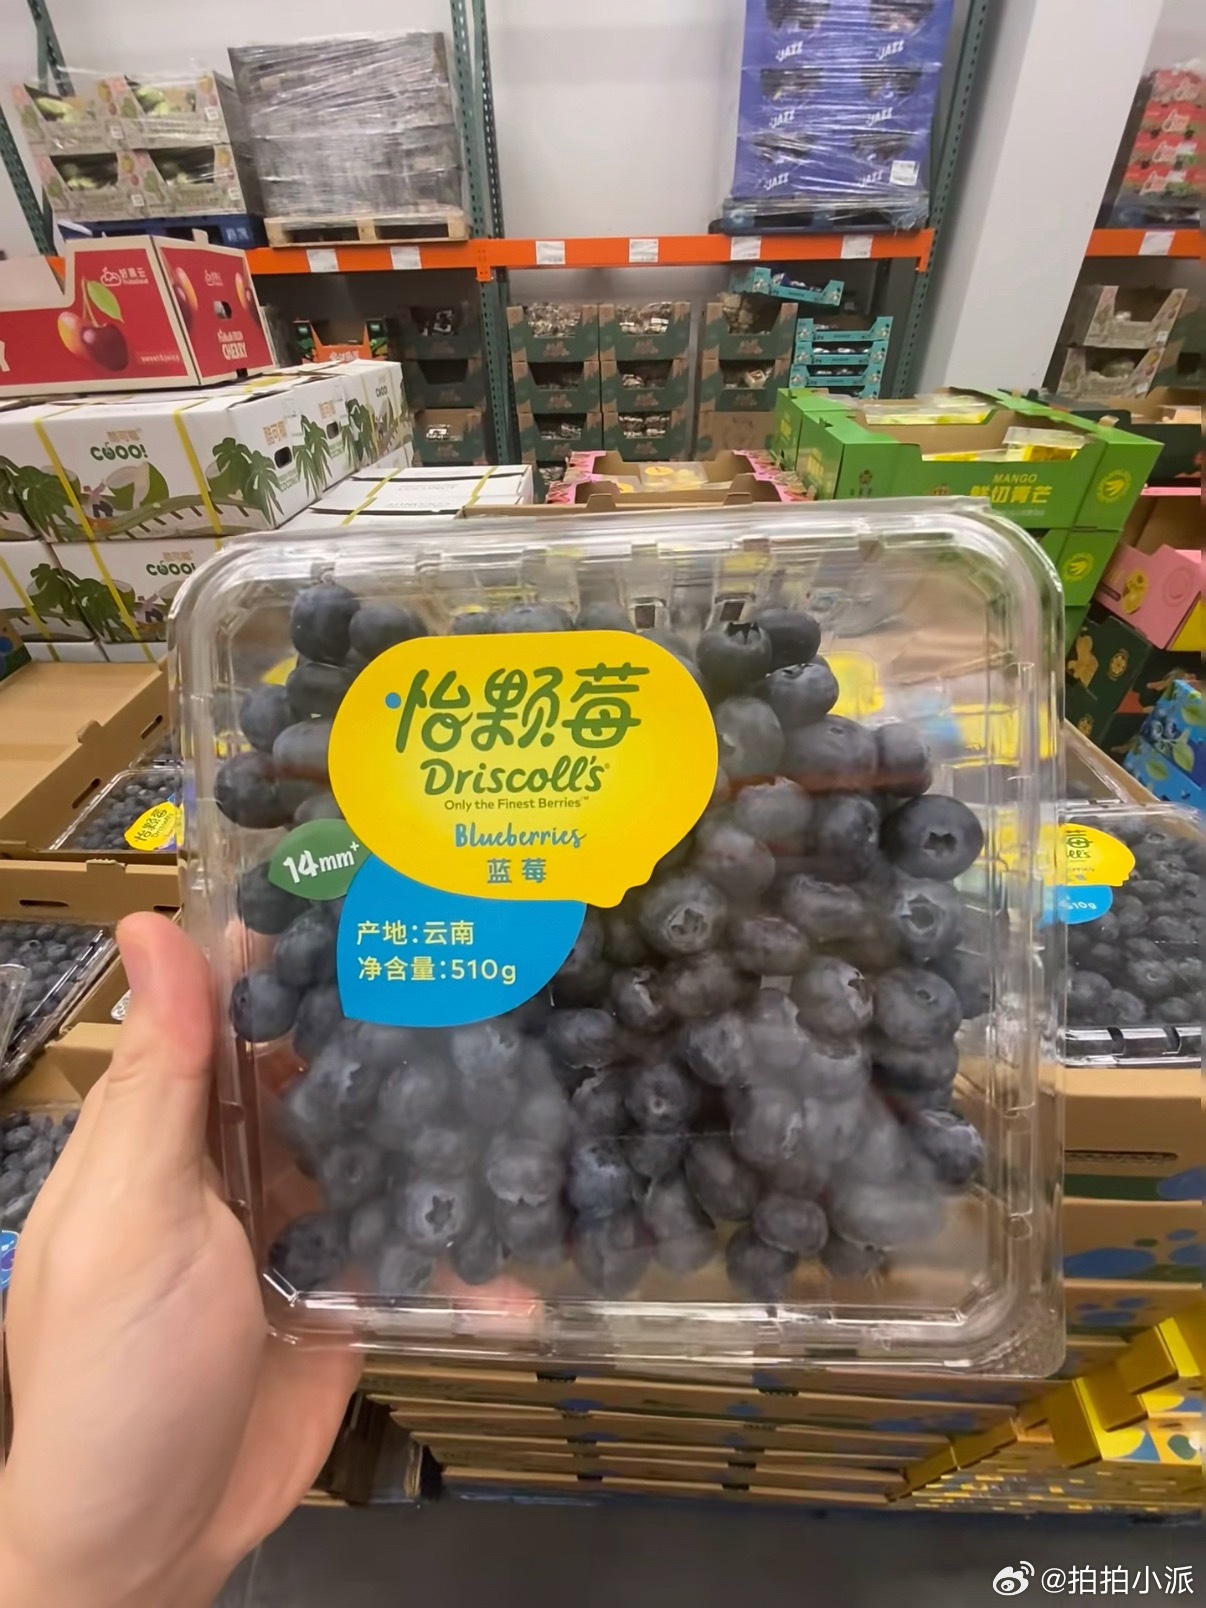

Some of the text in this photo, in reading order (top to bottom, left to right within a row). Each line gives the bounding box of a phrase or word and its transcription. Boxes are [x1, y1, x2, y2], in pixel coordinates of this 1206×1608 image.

[992, 473, 1038, 484] MANGO
[385, 662, 650, 753] 怡颗莓
[444, 797, 581, 812] Only the Finest Berries
[454, 822, 586, 848] Blueberries
[486, 858, 547, 884] 蓝莓
